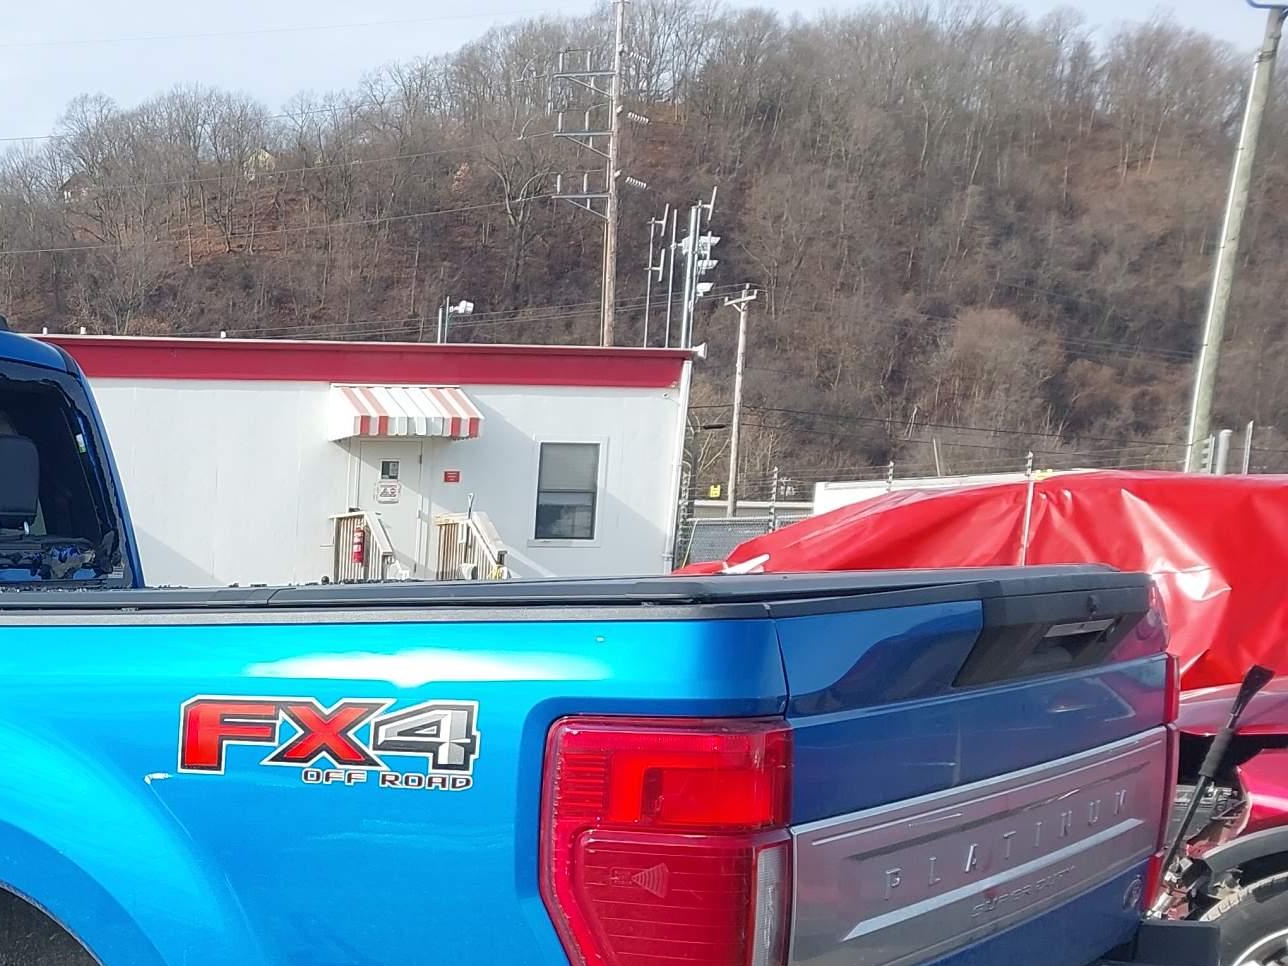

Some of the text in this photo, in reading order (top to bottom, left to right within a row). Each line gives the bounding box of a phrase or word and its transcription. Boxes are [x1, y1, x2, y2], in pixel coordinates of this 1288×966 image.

[178, 695, 480, 774] FX4
[302, 768, 473, 791] OFF ROAD
[884, 789, 1128, 900] PLATINUM
